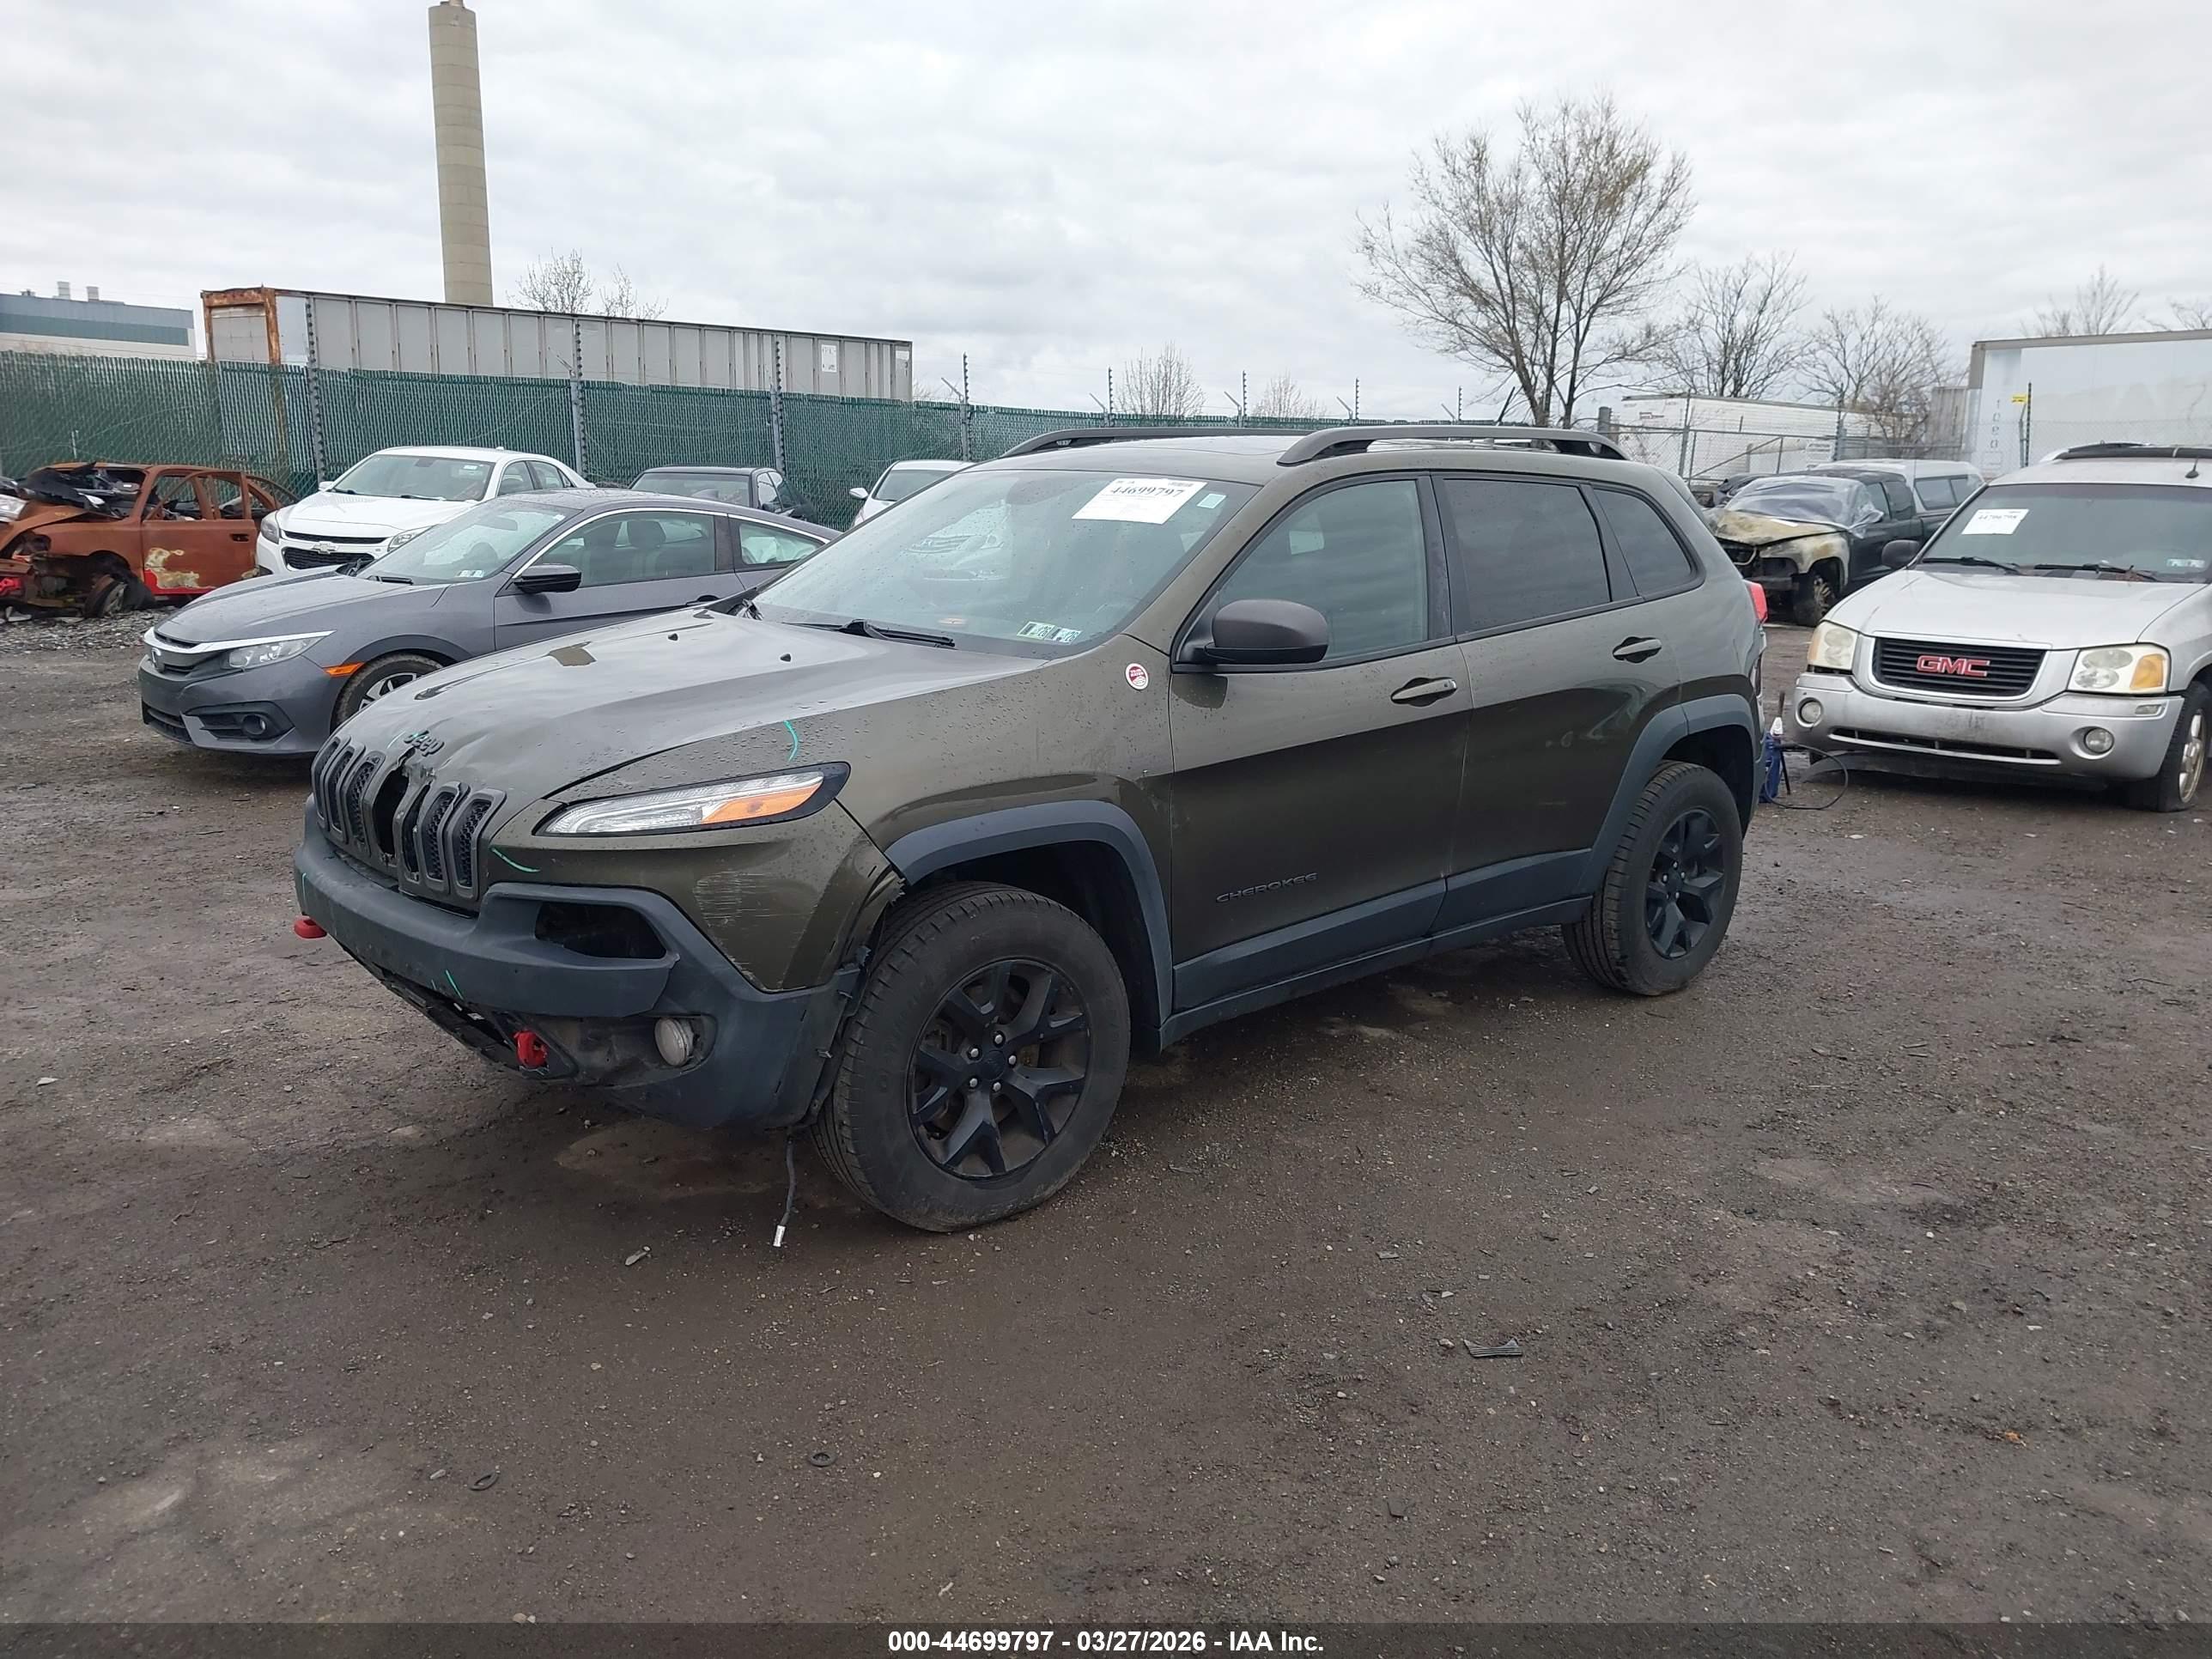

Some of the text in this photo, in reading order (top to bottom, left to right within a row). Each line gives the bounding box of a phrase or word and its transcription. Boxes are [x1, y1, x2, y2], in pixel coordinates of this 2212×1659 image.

[1111, 486, 1186, 497] 44699797
[1916, 654, 1990, 678] GMC
[403, 730, 445, 757] Jeep
[1216, 872, 1318, 903] CHEROKEE
